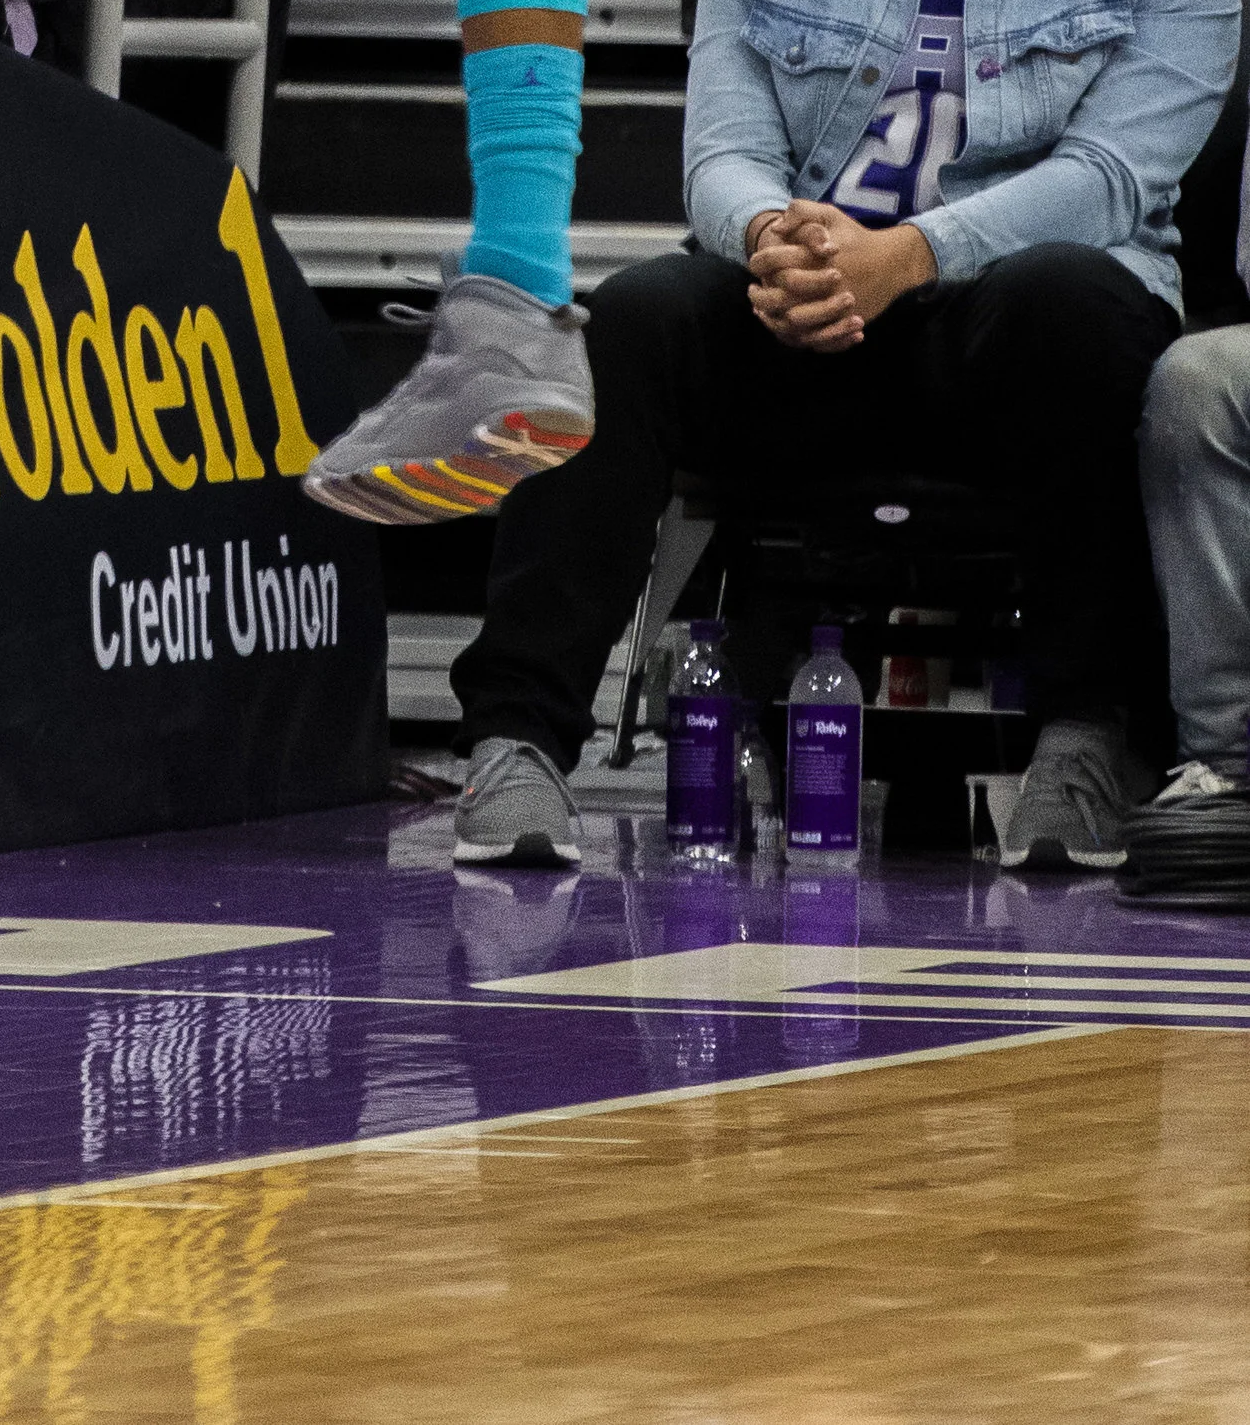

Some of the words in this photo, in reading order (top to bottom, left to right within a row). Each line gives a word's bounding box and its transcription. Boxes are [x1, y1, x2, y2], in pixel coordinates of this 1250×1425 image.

[219, 164, 321, 477] 1
[90, 543, 214, 671] Credit
[224, 534, 339, 657] Union
